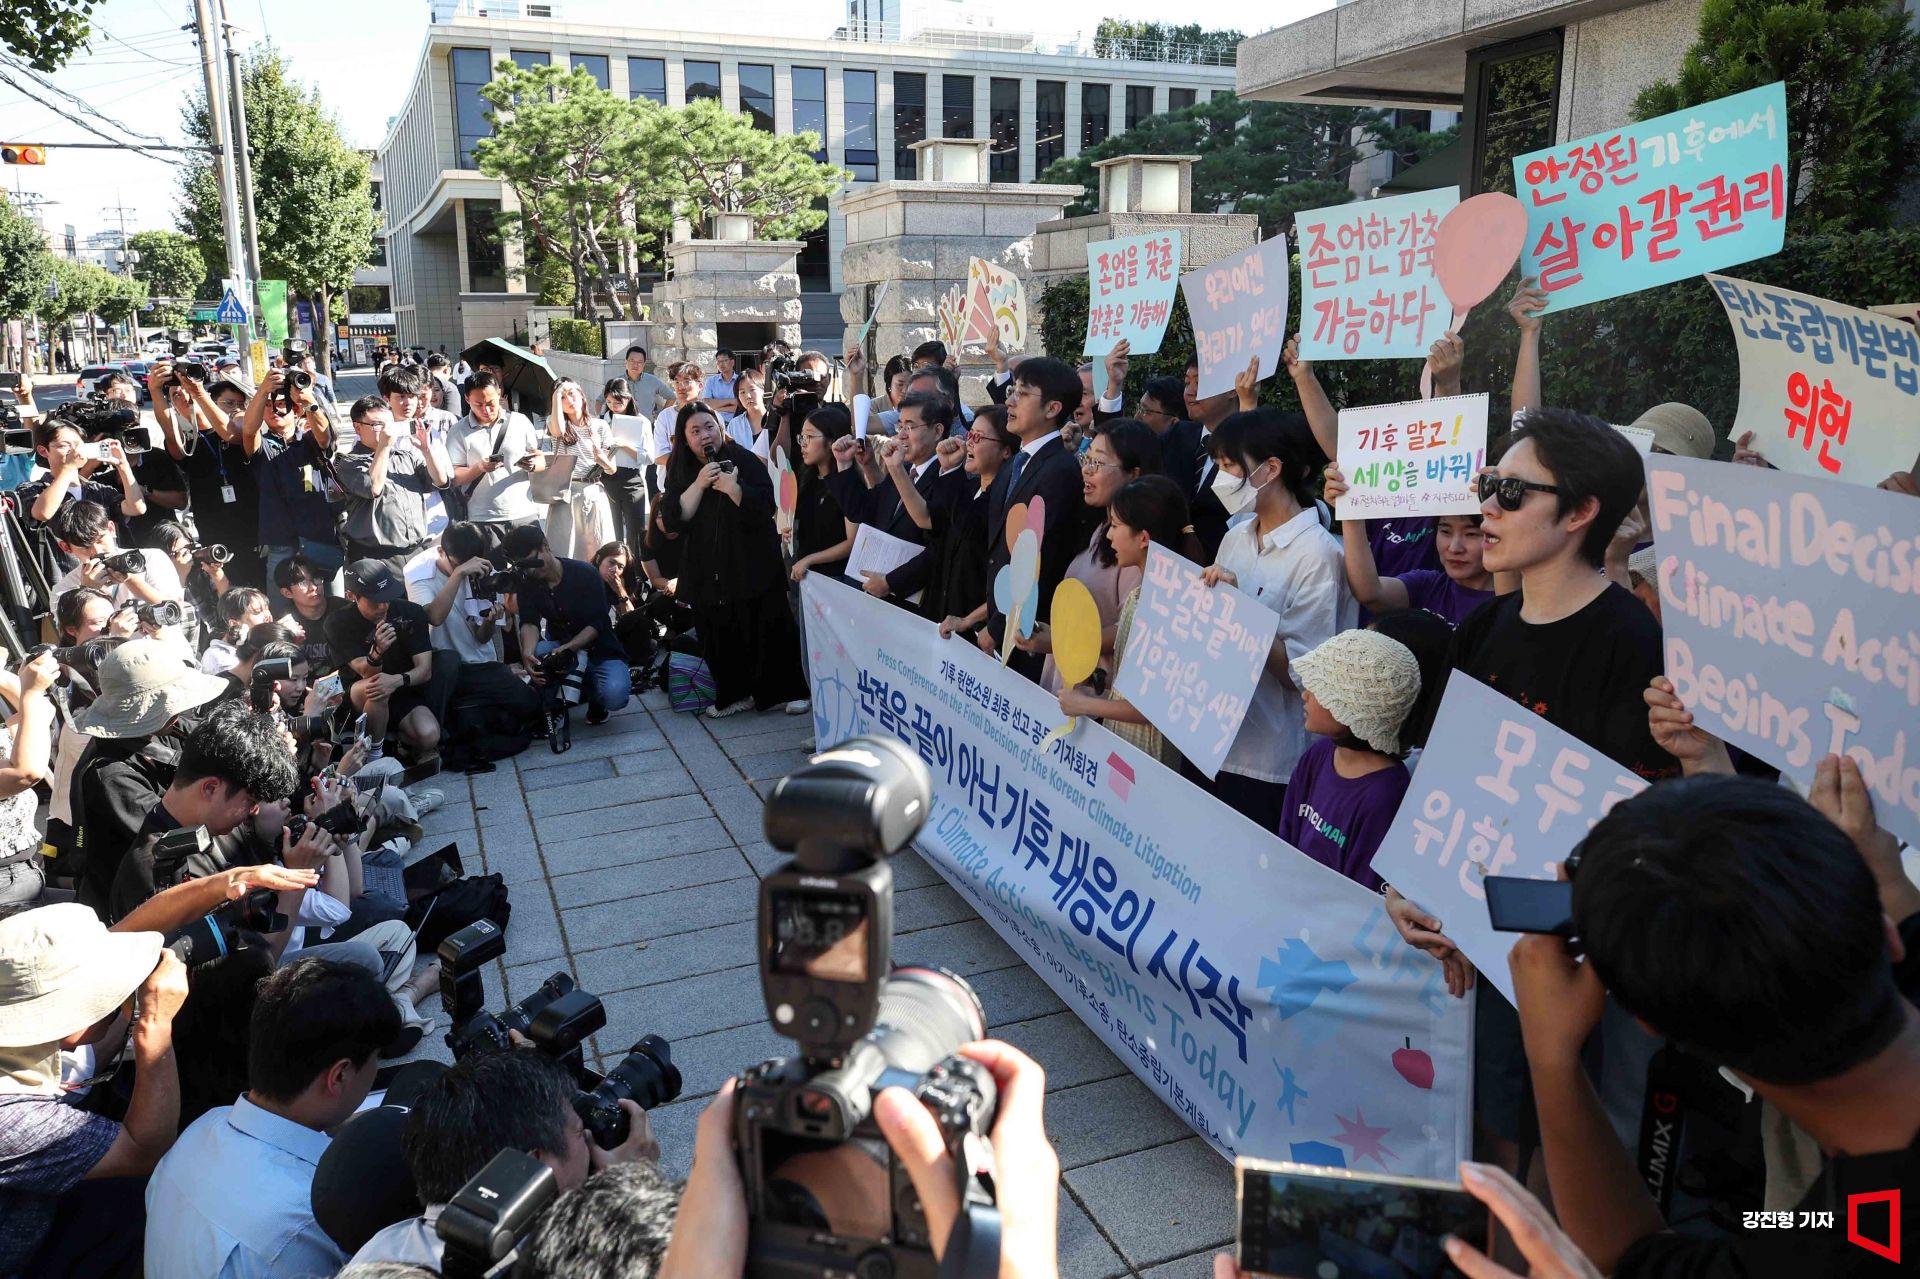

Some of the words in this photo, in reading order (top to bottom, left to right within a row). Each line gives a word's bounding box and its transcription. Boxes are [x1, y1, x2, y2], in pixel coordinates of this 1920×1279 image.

[1525, 135, 1638, 207] 안정된
[1641, 105, 1776, 168] 기후에서
[1097, 245, 1138, 296] 존엄을
[1145, 238, 1172, 281] 갖춘
[1307, 216, 1395, 289] 존엄한
[1091, 304, 1124, 339] 감축은
[1130, 299, 1168, 330] 가능해
[1313, 285, 1436, 354] 가능하다
[1713, 280, 1919, 395] 탄소중립기본법
[1358, 423, 1398, 452] 기후
[1407, 414, 1463, 451] 말고!
[1784, 372, 1852, 474] 위헌
[1353, 460, 1419, 493] 세상을
[1650, 470, 1781, 568] Final
[1660, 555, 1814, 658] Climate
[941, 660, 956, 684] 기후
[958, 670, 992, 709] 헌법소원
[991, 693, 1010, 722] 최종
[1013, 707, 1030, 736] 선고
[1032, 720, 1052, 747] 공
[1053, 739, 1098, 788] 기자회견
[1666, 637, 1812, 767] Begins
[877, 648, 897, 670] Press
[898, 661, 937, 697] Conference
[939, 689, 948, 702] on
[950, 694, 961, 714] the
[963, 702, 982, 727] Final
[983, 720, 1019, 759] Decision
[1020, 748, 1032, 771] of
[1032, 752, 1047, 780] the
[1049, 768, 1087, 811] Korean
[1088, 796, 1133, 847] Climate
[1134, 834, 1202, 904] Litigation
[76, 825, 84, 848] Nikon
[857, 669, 911, 745] 판결은
[912, 703, 954, 784] 끝이
[959, 742, 1000, 829] 아닌
[1146, 930, 1254, 1065] 시작
[1412, 789, 1517, 900] 위한
[936, 807, 989, 880] Climate
[985, 866, 1058, 944] Action
[1057, 926, 1157, 1026] Begins
[1162, 1002, 1256, 1139] Today
